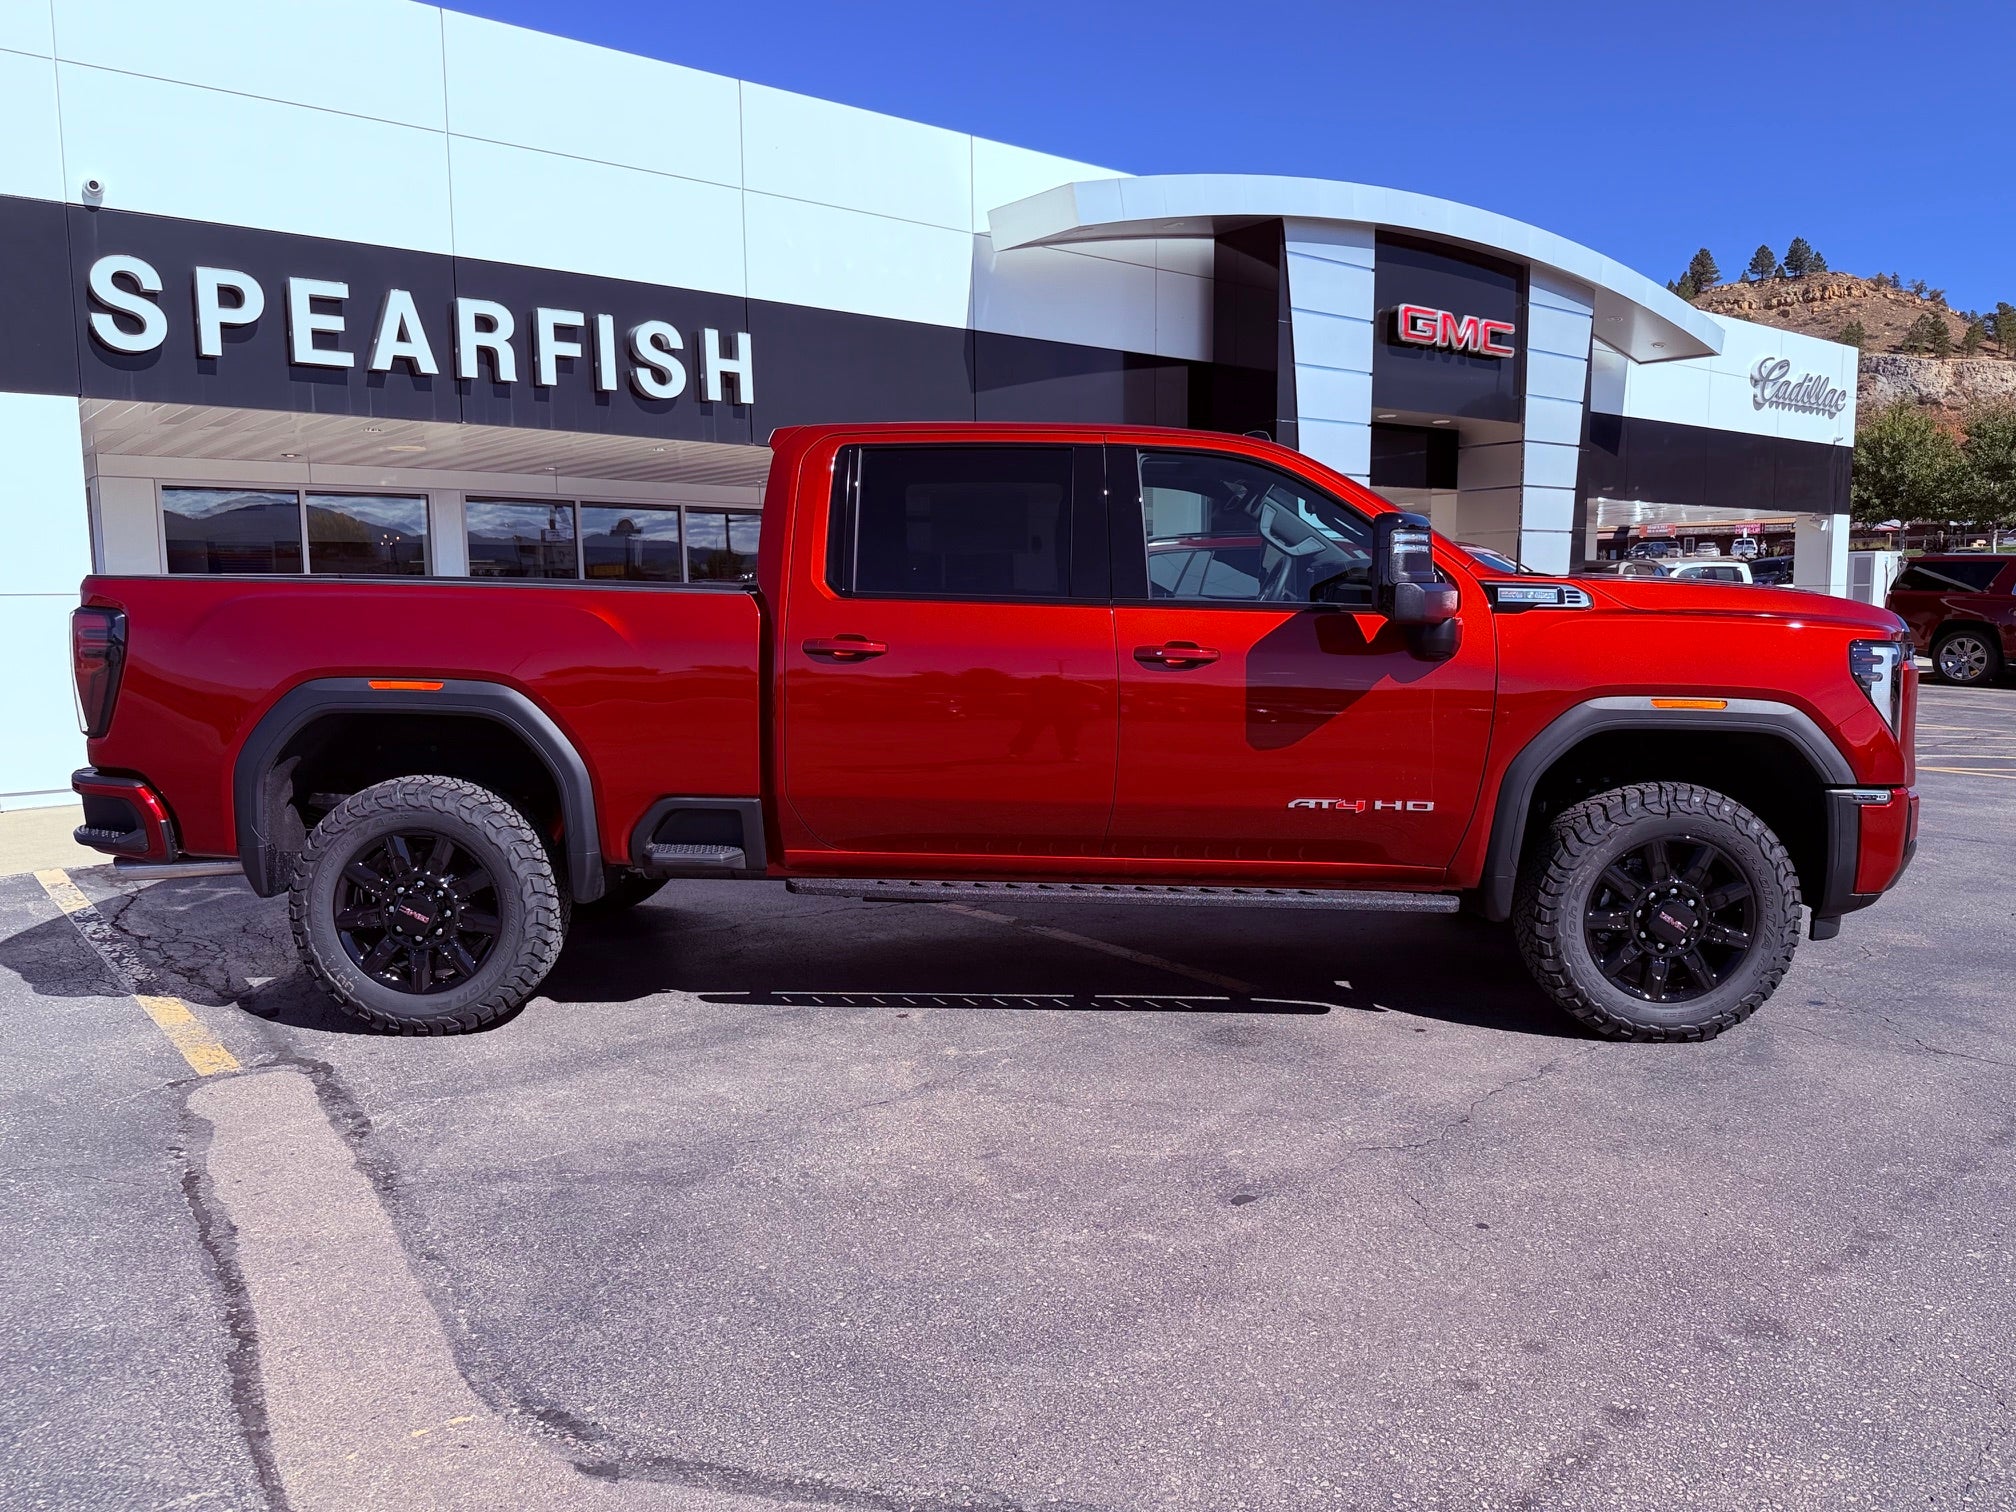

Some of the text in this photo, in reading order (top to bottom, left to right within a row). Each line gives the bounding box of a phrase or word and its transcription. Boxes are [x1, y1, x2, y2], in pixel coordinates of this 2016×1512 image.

[88, 254, 754, 404] SPEARFISH
[1398, 303, 1515, 358] GMC
[1750, 357, 1847, 412] Cadillac
[1288, 798, 1434, 813] AT4 HD
